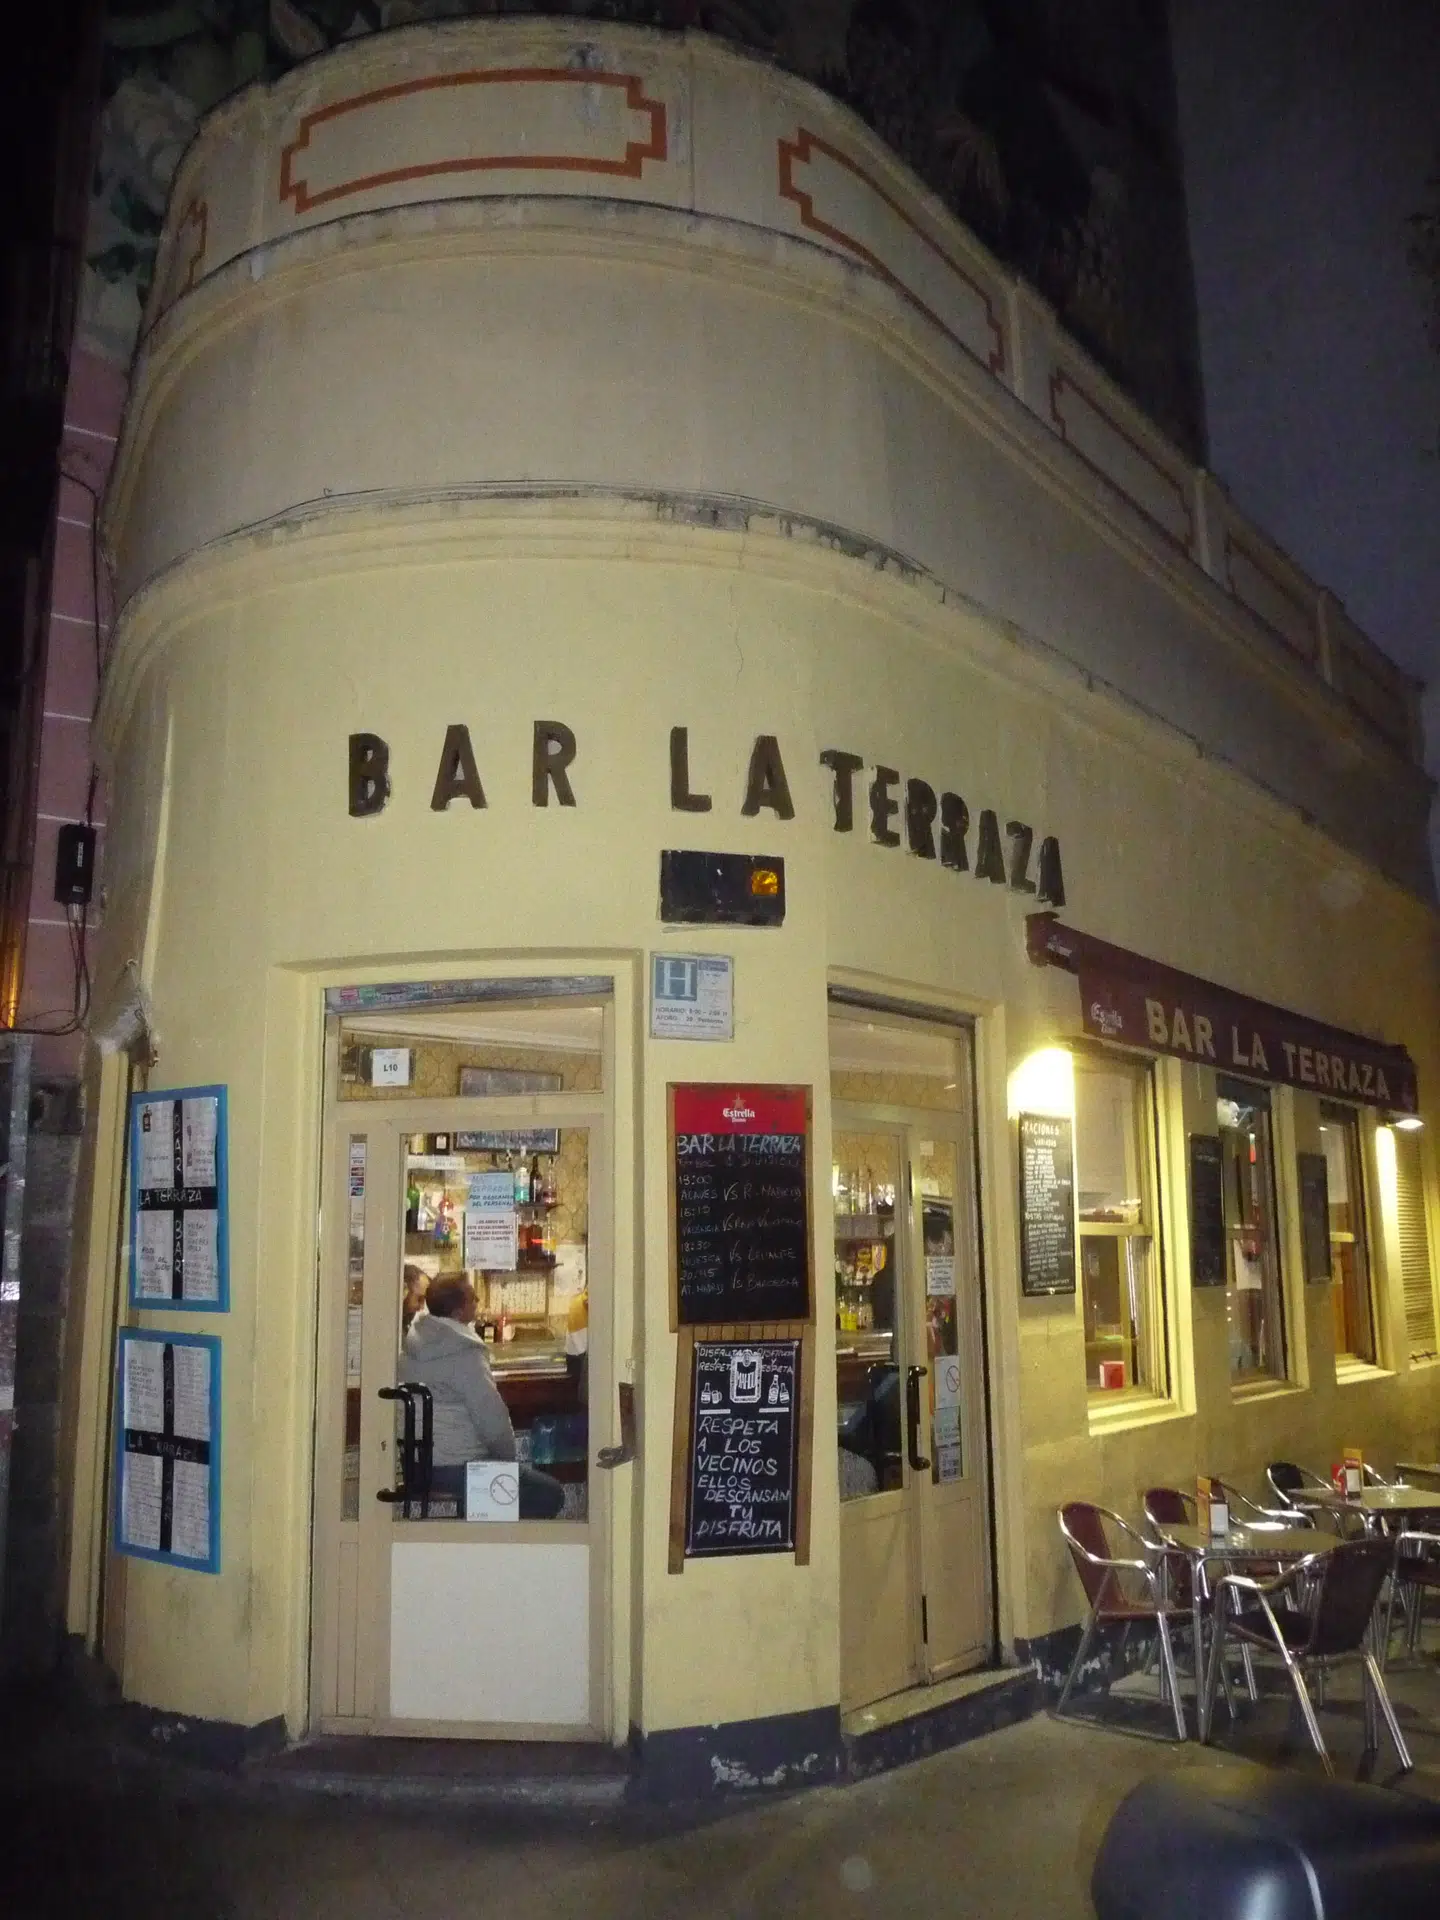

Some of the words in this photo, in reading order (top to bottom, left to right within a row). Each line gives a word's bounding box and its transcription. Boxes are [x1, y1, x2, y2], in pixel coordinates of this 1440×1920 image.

[348, 720, 578, 818] BAR
[669, 725, 796, 820] LA
[820, 749, 1066, 907] TERRAZA
[659, 959, 697, 998] H
[1144, 998, 1217, 1059] BAR
[1232, 1024, 1270, 1073] LA
[1281, 1041, 1391, 1101] TERRAZA
[383, 1063, 399, 1072] L10
[722, 1107, 756, 1119] Estrella
[677, 1134, 715, 1155] BAR
[718, 1133, 736, 1152] LA
[740, 1134, 801, 1154] TERRAZA
[138, 1188, 151, 1206] LA
[155, 1186, 202, 1203] TERRAZA
[761, 1364, 794, 1374] ESPETA
[699, 1416, 779, 1435] RESPETA
[697, 1436, 707, 1452] A
[724, 1438, 762, 1454] LOS
[697, 1455, 778, 1476] VECINOS
[697, 1475, 752, 1491] ELLOS
[704, 1489, 791, 1505] DESCANSAN
[729, 1505, 753, 1520] TU
[696, 1520, 783, 1539] DISFRUTA
